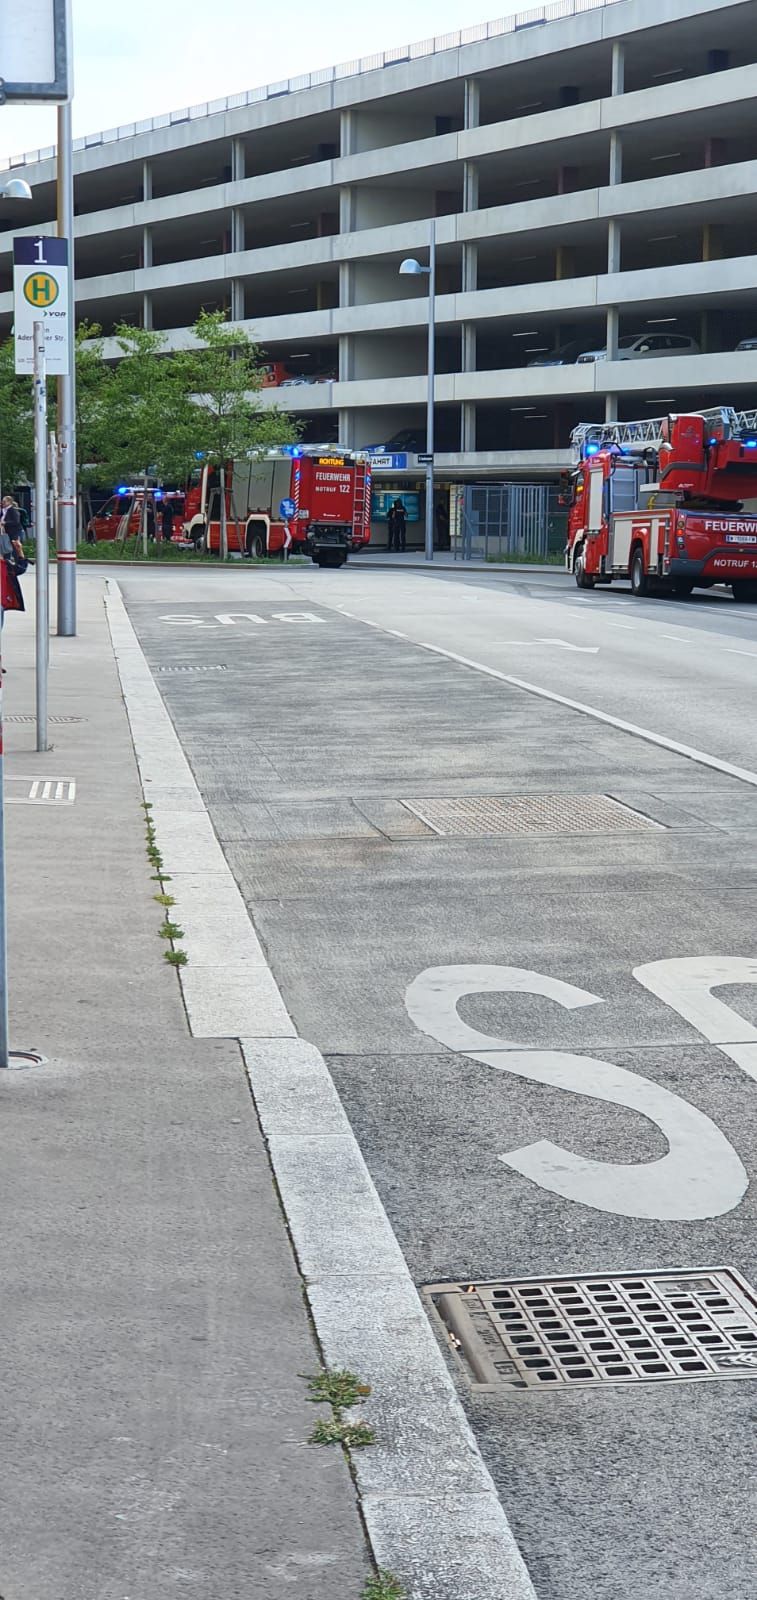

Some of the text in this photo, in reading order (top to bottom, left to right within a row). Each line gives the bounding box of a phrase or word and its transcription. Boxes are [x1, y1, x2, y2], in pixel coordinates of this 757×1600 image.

[34, 240, 47, 264] 1
[32, 279, 50, 301] H
[316, 472, 350, 481] FEUERWEHR
[339, 484, 350, 493] 122
[713, 559, 750, 568] NOTRUF
[158, 612, 326, 628] BUS
